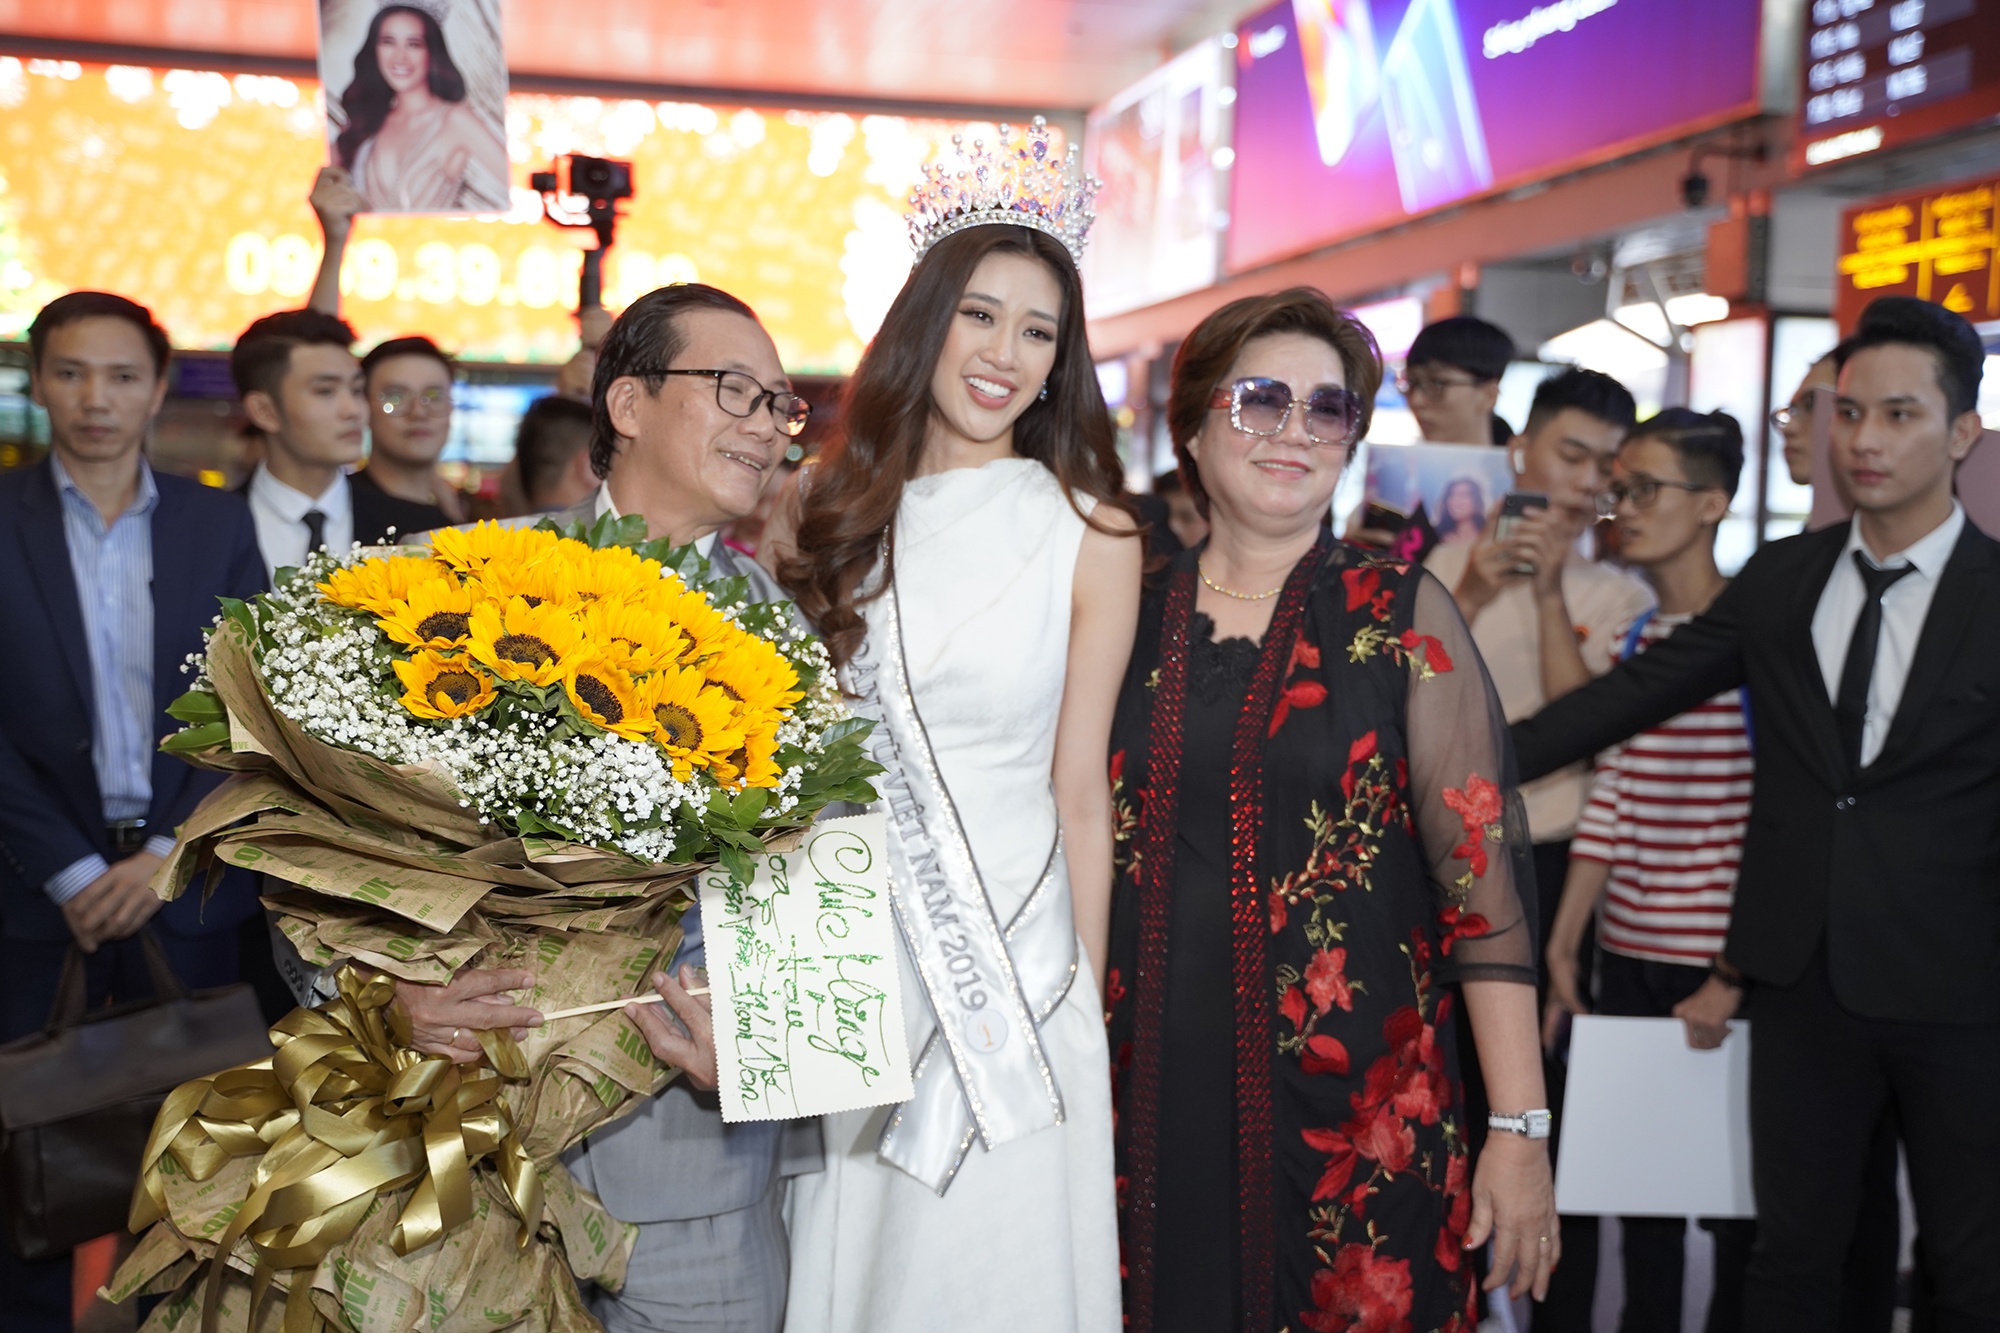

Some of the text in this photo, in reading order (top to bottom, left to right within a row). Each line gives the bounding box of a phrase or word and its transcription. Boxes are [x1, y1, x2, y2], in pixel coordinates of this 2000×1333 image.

[415, 903, 434, 919] LOVE
[883, 768, 930, 842] VIỆT
[908, 848, 960, 931] NAM
[939, 934, 988, 1012] 2019
[615, 1023, 652, 1068] OVE
[196, 1183, 217, 1198] LOVE
[583, 1210, 607, 1257] LOV
